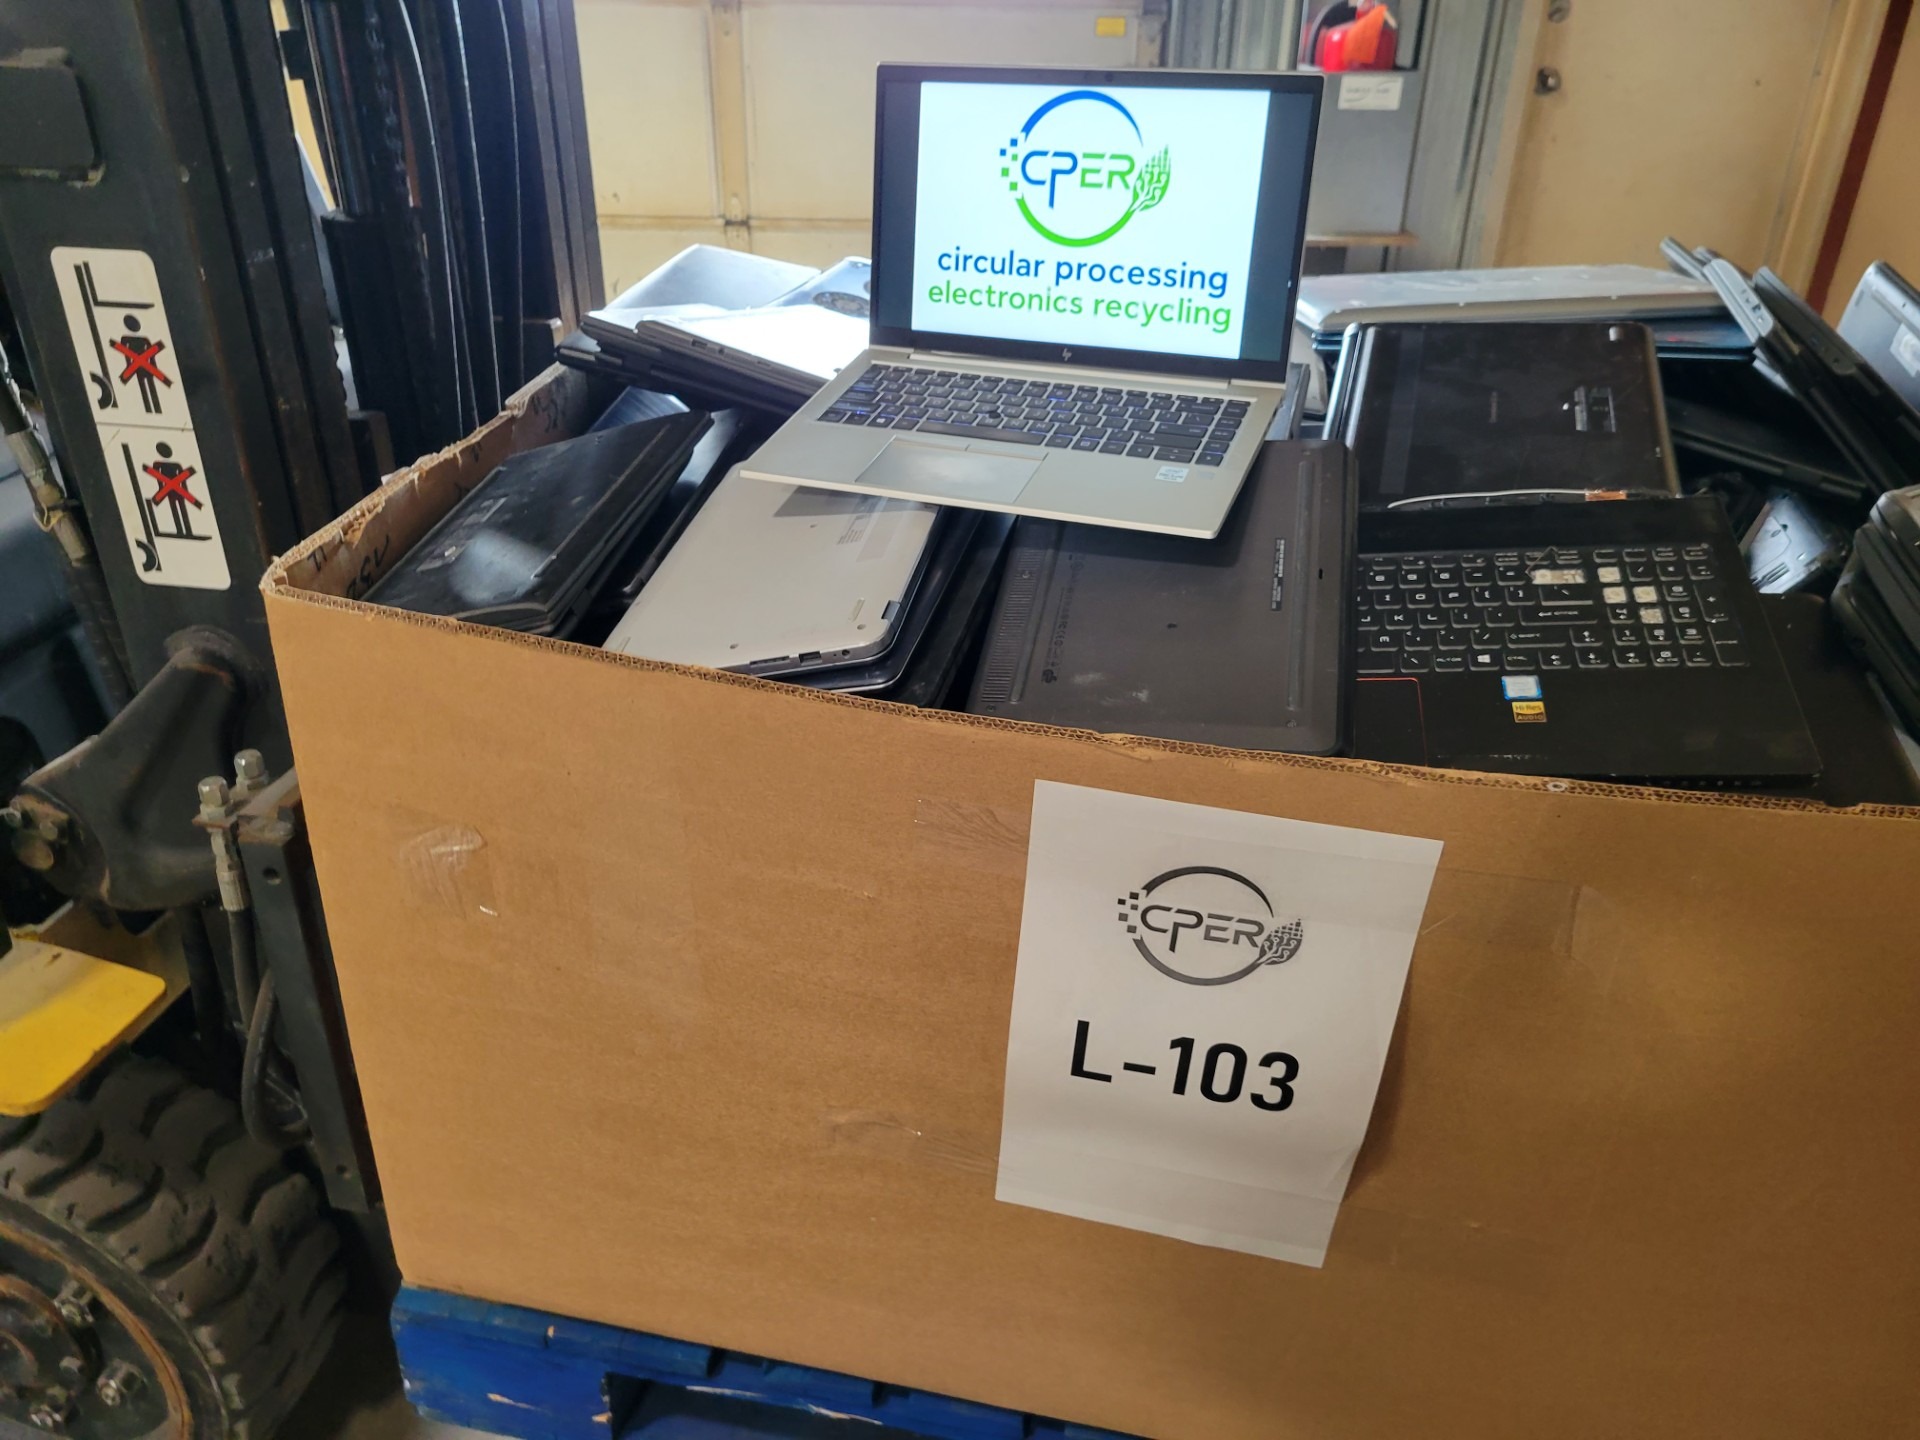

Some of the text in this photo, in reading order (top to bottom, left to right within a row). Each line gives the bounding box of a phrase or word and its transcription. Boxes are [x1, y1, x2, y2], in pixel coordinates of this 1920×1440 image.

[1020, 149, 1136, 209] CPER
[937, 246, 1228, 299] circular processing
[928, 280, 1231, 334] electronics recycling
[1140, 904, 1265, 953] CPER
[1069, 1018, 1301, 1113] L-103
